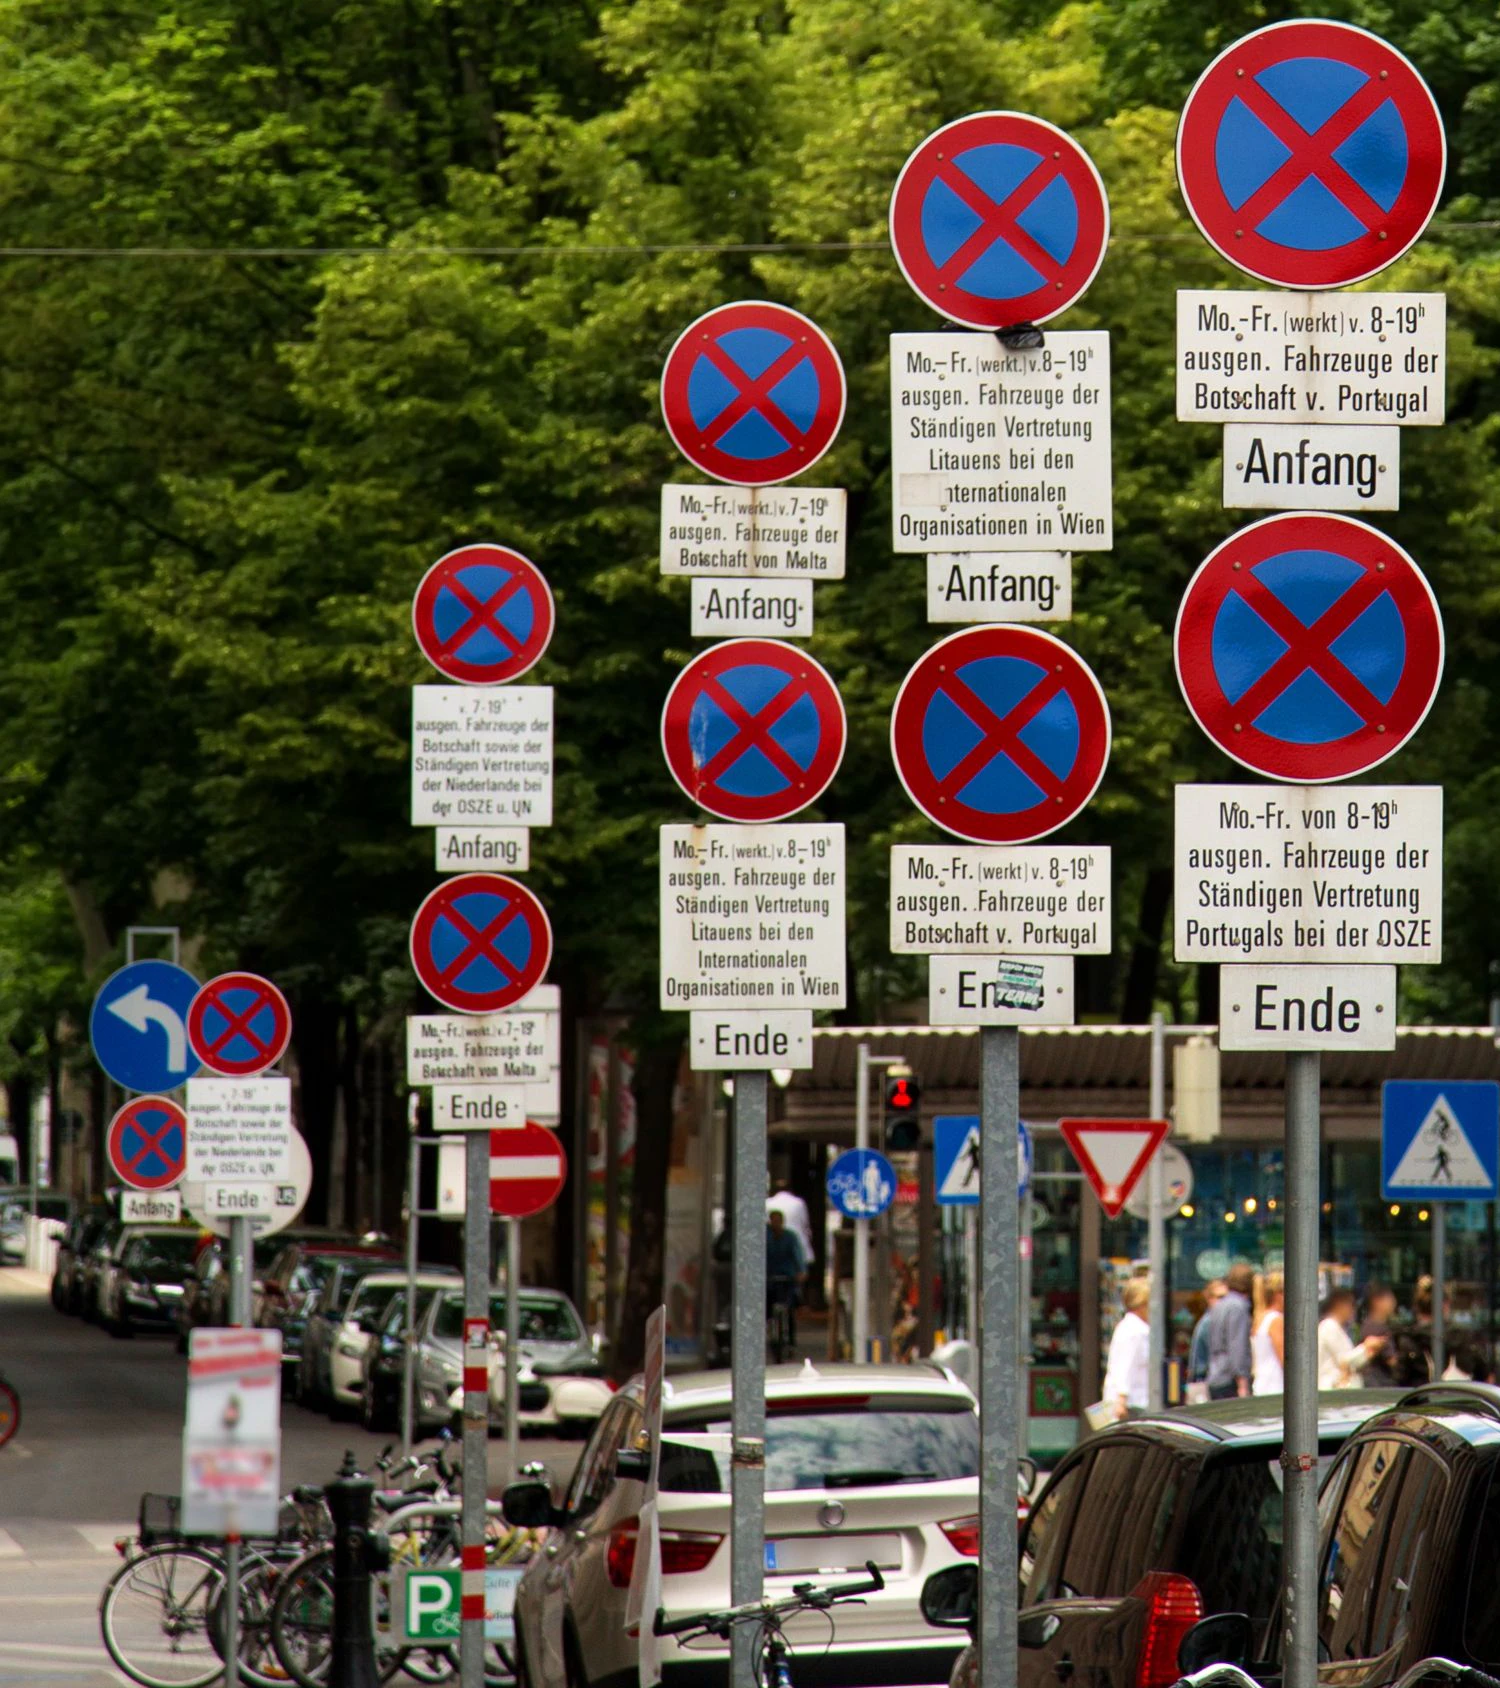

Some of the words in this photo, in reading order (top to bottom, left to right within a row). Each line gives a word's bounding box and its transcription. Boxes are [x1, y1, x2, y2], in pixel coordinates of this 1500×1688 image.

[1198, 304, 1278, 332] Mo.-Fr.
[1349, 320, 1363, 333] v.
[1185, 351, 1270, 377] ausgen.
[1284, 345, 1392, 378] Fahrzeuge
[1404, 347, 1438, 373] der
[902, 388, 968, 411] ausgen.
[979, 383, 1063, 410] Fahrzeuge
[1073, 382, 1099, 405] der
[1195, 383, 1296, 410] Botschaft
[1306, 392, 1325, 411] v.
[1339, 385, 1428, 418] Portugal
[910, 416, 996, 443] Ständigen
[1004, 415, 1092, 442] Vertretung
[930, 448, 1000, 470] Litauens
[1010, 448, 1034, 469] bei
[1044, 448, 1074, 469] den
[1243, 438, 1376, 498] Anfang
[945, 480, 1066, 503] nternationalen
[669, 525, 726, 544] ausgen.
[736, 523, 808, 546] Fahrzeuge
[815, 525, 838, 543] der
[900, 512, 1027, 541] Organisationen
[1037, 514, 1051, 535] in
[1060, 512, 1104, 535] Wien
[680, 548, 747, 567] Botschaft
[754, 554, 777, 569] von
[786, 551, 827, 570] Malta
[945, 564, 1054, 611] Anfang
[705, 588, 797, 628] Anfang
[416, 720, 461, 732] ausgen.
[466, 718, 526, 733] Fahrzeuge
[531, 720, 549, 732] der
[422, 739, 481, 752] Botschaft
[485, 741, 519, 752] sowie
[523, 740, 542, 752] der
[415, 757, 479, 773] Ständigen
[482, 757, 549, 774] Vertretung
[422, 778, 442, 792] der
[446, 778, 520, 792] Niederlande
[524, 778, 542, 792] bei
[432, 801, 452, 816] der
[458, 799, 492, 814] OSZE
[1220, 802, 1290, 829] Mo.-Fr.
[1302, 809, 1335, 829] von
[447, 834, 518, 864] Anfang
[1189, 849, 1271, 875] ausgen.
[1284, 842, 1385, 875] Fahrzeuge
[1396, 842, 1429, 868] der
[669, 872, 726, 890] ausgen.
[734, 868, 806, 890] Fahrzeuge
[813, 868, 836, 886] der
[908, 857, 973, 879] Mo.-Fr.
[1032, 869, 1043, 879] v.
[676, 895, 748, 918] Ständigen
[755, 895, 829, 917] Vertretung
[897, 895, 967, 917] ausgen.
[979, 890, 1067, 917] Fahrzeuge
[1077, 890, 1104, 912] der
[1199, 880, 1302, 913] Ständigen
[1313, 881, 1419, 914] Vertretung
[692, 921, 752, 941] Litauens
[759, 922, 780, 940] bei
[788, 922, 813, 940] den
[906, 921, 988, 943] Botschaft
[997, 928, 1012, 944] v.
[1023, 922, 1096, 949] Portugal
[1187, 920, 1283, 952] Portugals
[1295, 920, 1325, 946] bei
[1336, 920, 1368, 947] der
[1377, 920, 1431, 947] OSZE
[699, 950, 807, 969] Internationalen
[667, 977, 774, 1000] Organisationen
[782, 977, 794, 996] in
[802, 977, 839, 996] Wien
[1255, 984, 1360, 1032] Ende
[414, 1047, 458, 1060] ausgen.
[465, 1043, 520, 1059] Fahrzeuge
[526, 1044, 544, 1056] der
[715, 1024, 788, 1056] Ende
[423, 1065, 475, 1078] Botschaft
[479, 1066, 498, 1076] von
[504, 1063, 536, 1077] Malta
[451, 1094, 507, 1119] Ende
[130, 1199, 174, 1218] Anfang
[216, 1189, 258, 1208] Ende
